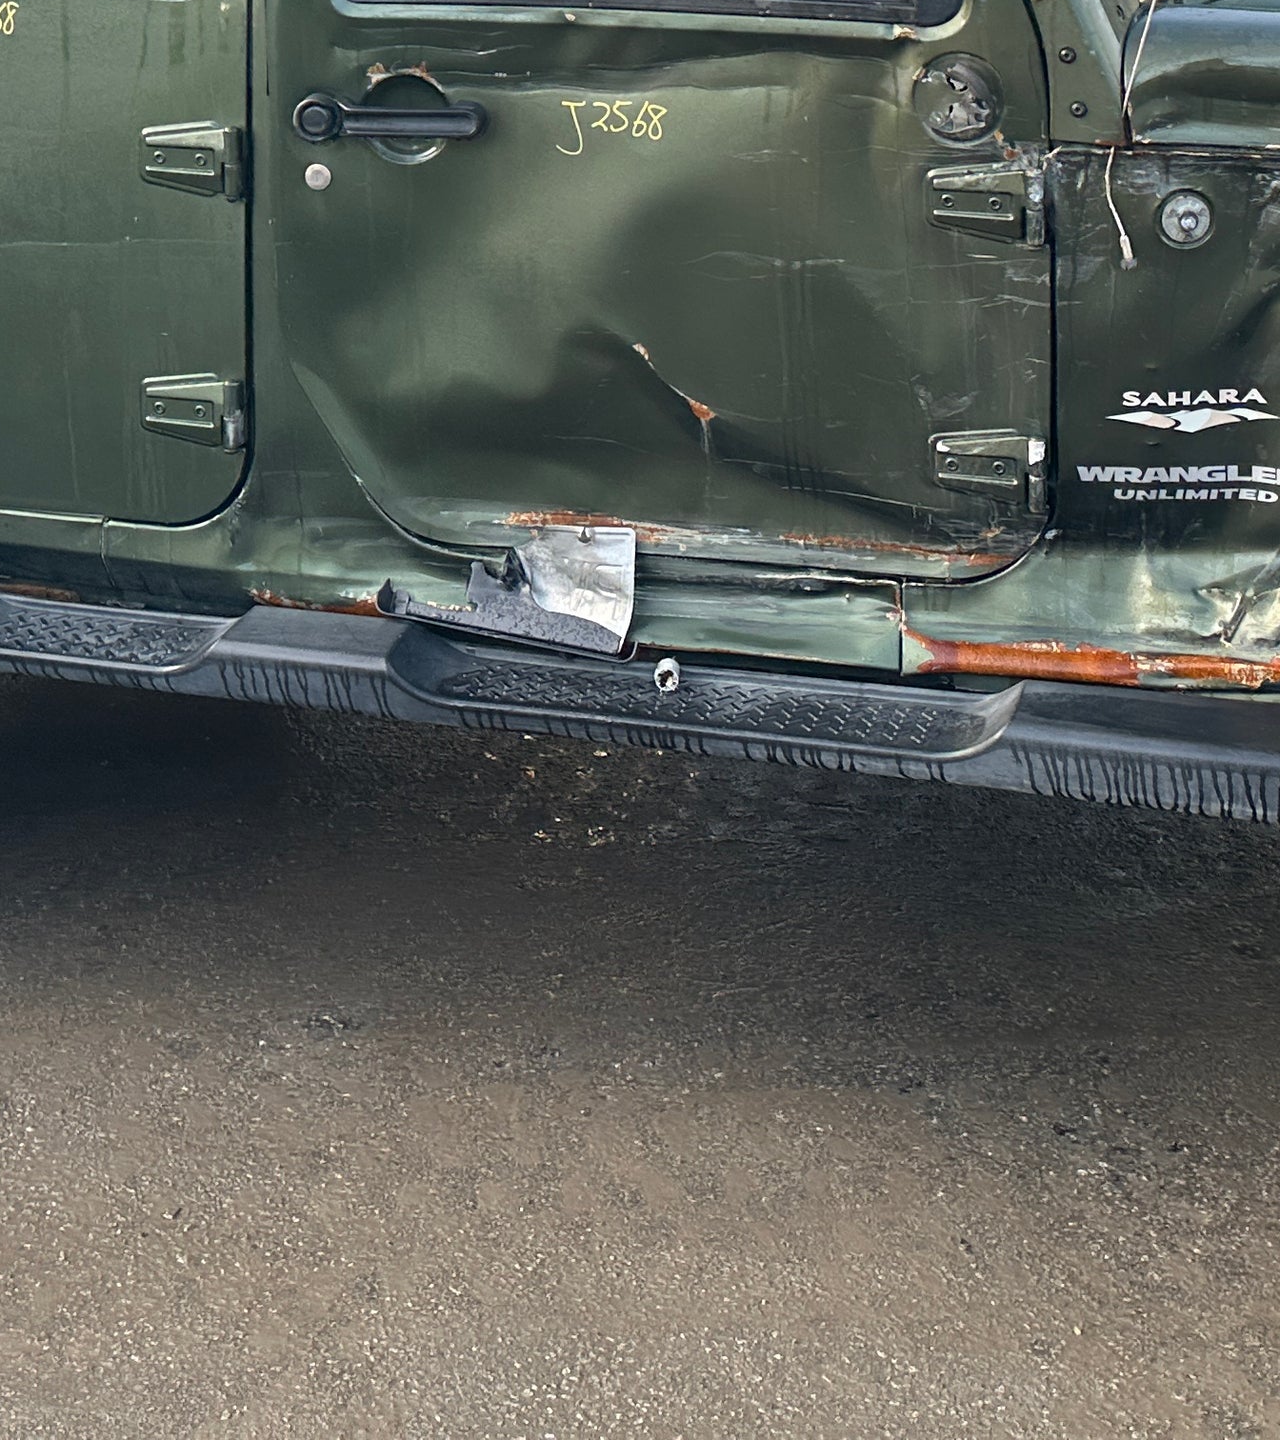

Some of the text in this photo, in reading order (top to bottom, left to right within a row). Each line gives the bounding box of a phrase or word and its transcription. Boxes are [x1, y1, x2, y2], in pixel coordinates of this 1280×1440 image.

[555, 100, 668, 156] J2568
[1121, 387, 1269, 408] SAHARA
[1113, 487, 1280, 504] UNLIMITED
